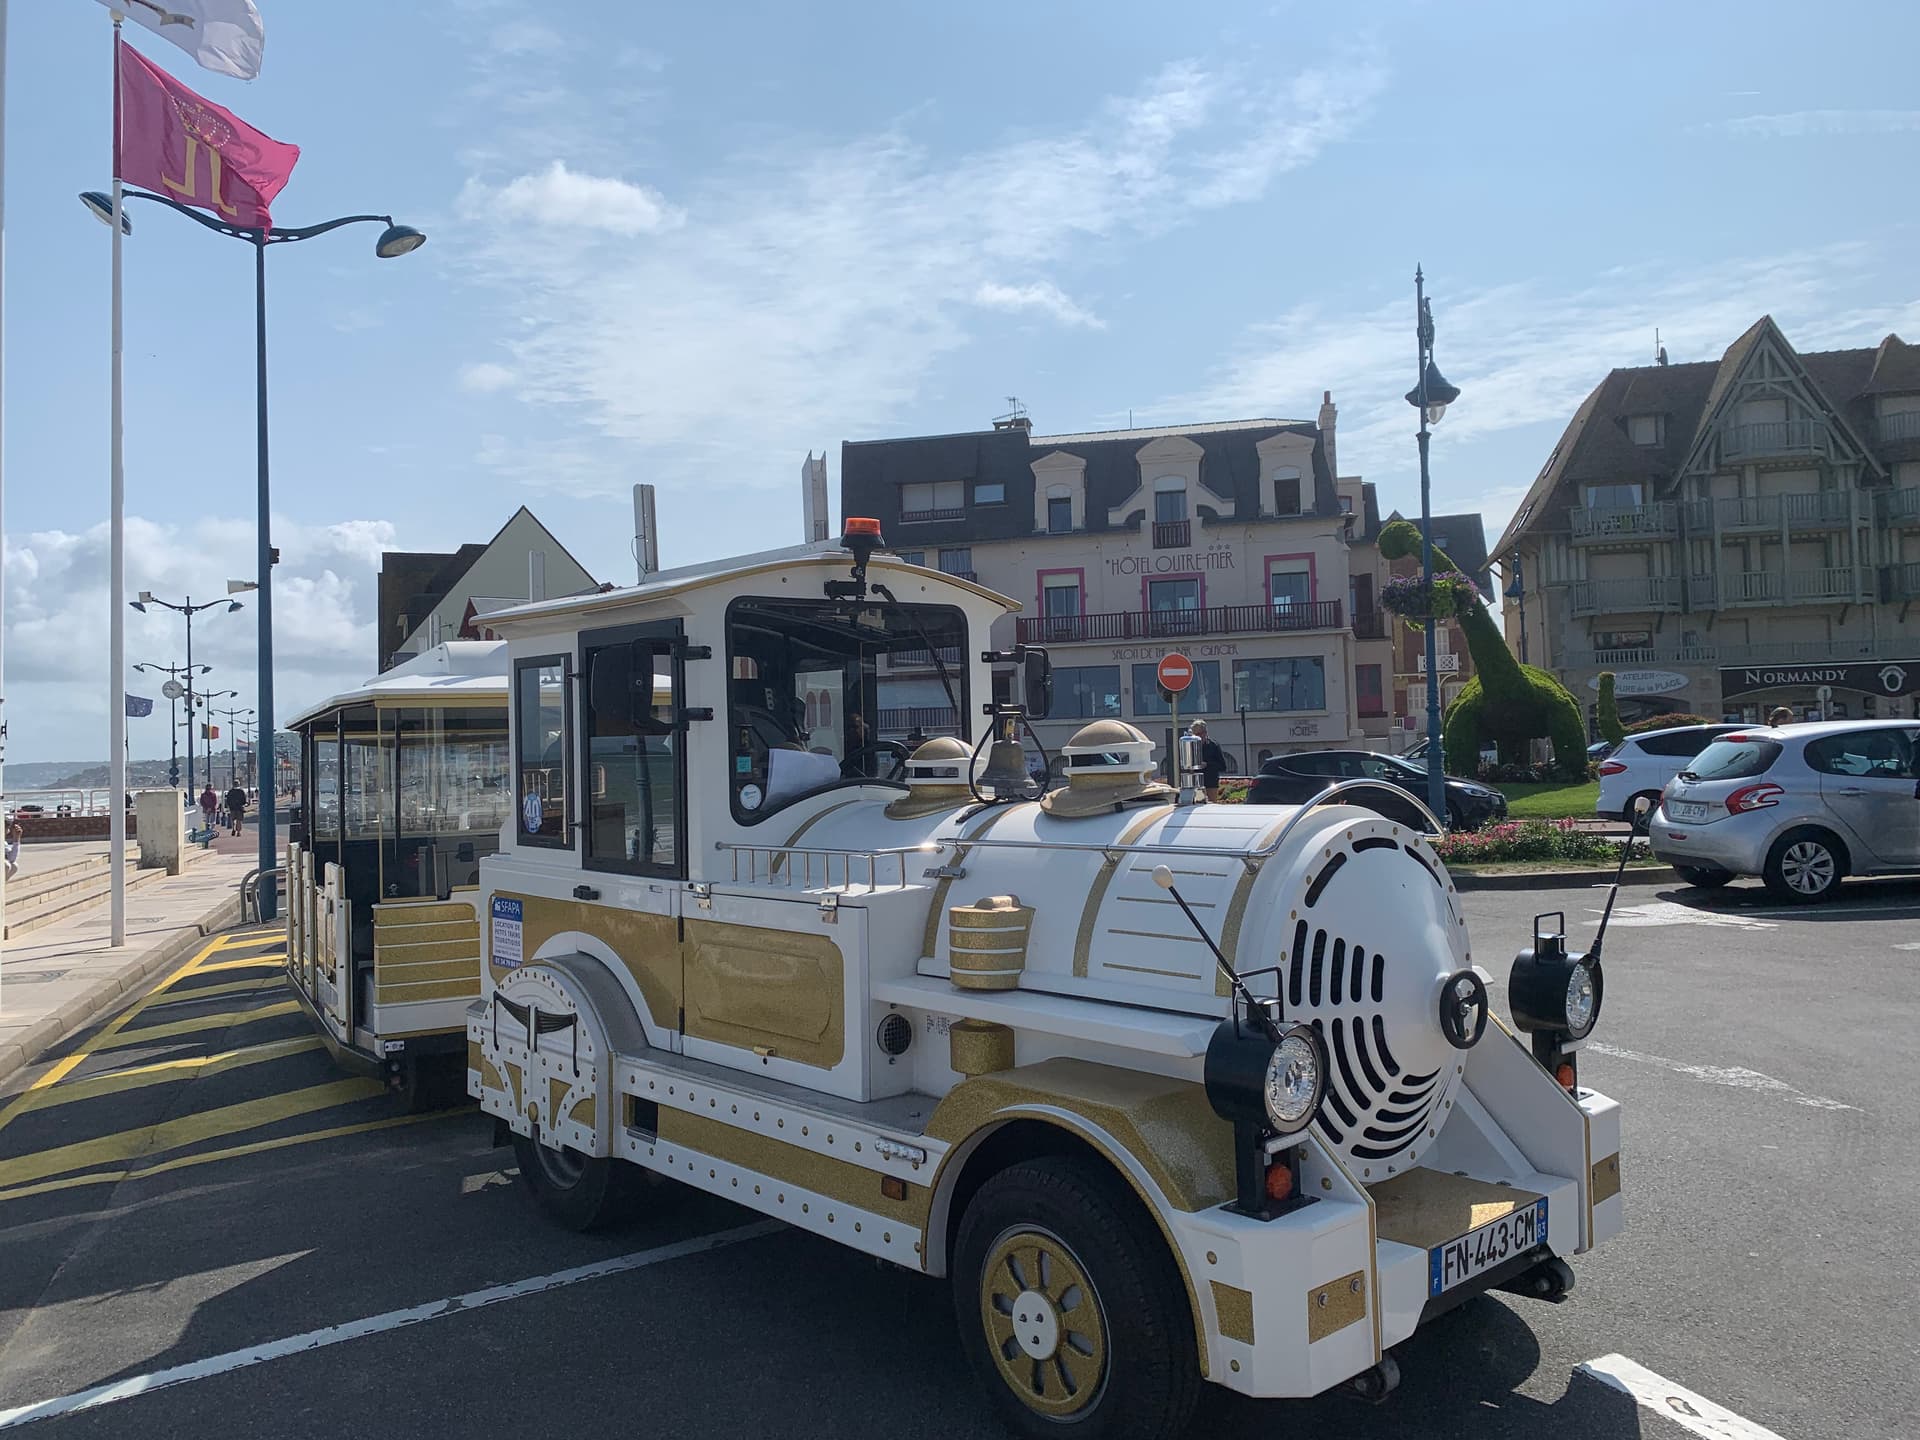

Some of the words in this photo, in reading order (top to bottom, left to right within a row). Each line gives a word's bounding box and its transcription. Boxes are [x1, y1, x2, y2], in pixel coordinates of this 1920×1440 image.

[1622, 672, 1655, 681] ATELIER
[1745, 669, 1848, 684] NORMANDY
[1654, 678, 1682, 691] PLAGE
[1444, 1208, 1536, 1285] FN-443-CM
[1433, 1277, 1439, 1288] F
